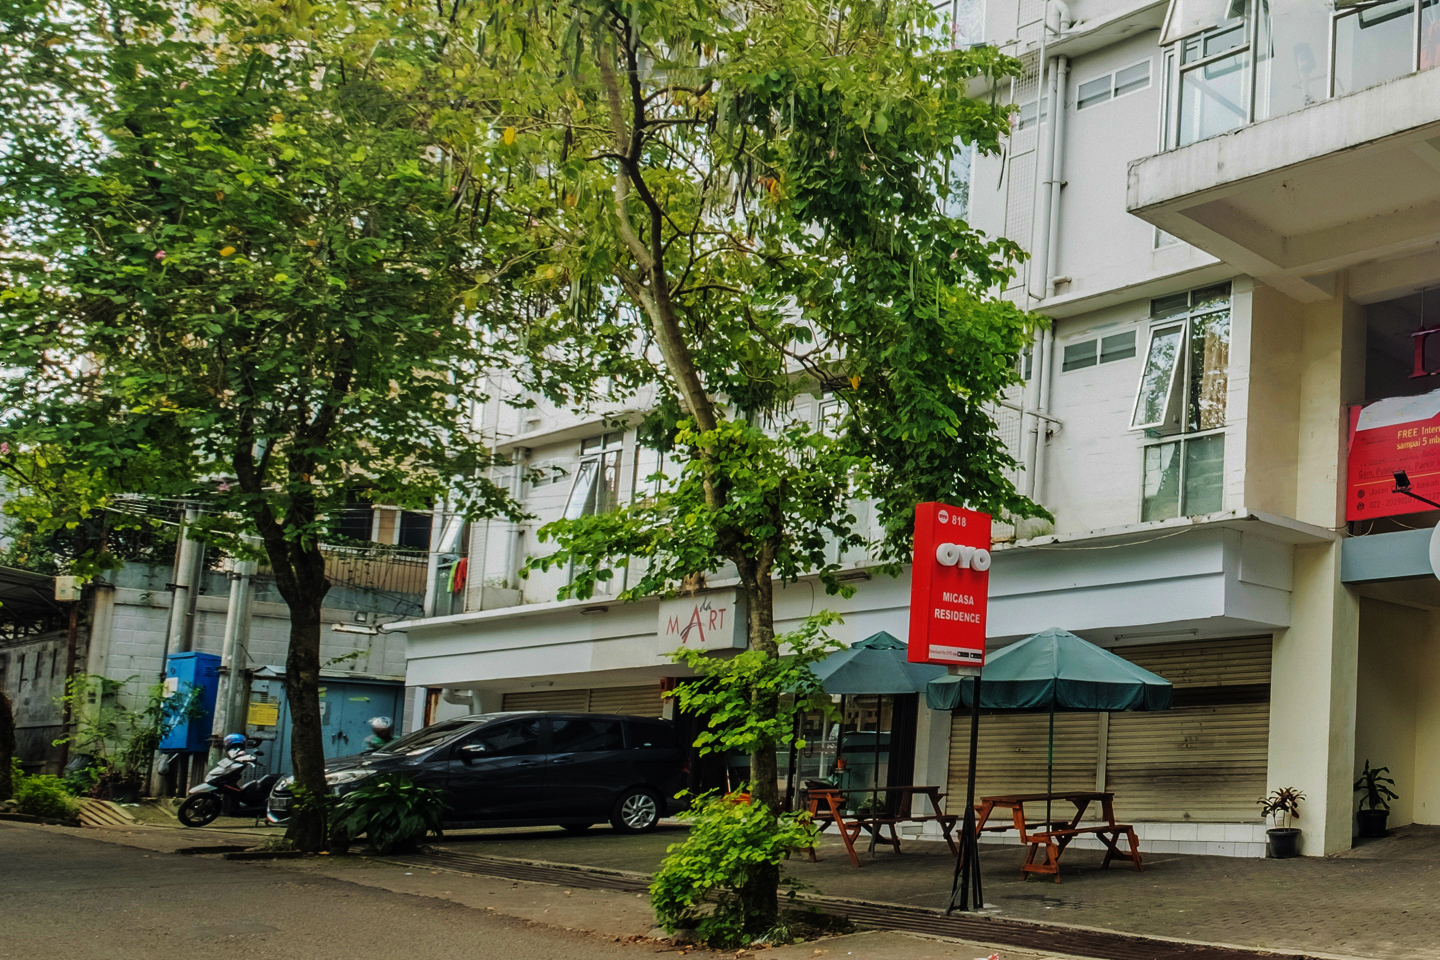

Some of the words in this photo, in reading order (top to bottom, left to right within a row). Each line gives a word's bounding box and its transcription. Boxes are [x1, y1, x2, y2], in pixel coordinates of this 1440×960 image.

[1397, 428, 1418, 440] FREE
[1396, 438, 1421, 450] sampai
[1422, 437, 1427, 446] 5
[1414, 460, 1435, 469] Parkir
[1416, 479, 1440, 489] bawah
[952, 515, 967, 528] 818
[935, 542, 992, 572] OYO
[942, 592, 975, 606] MICASA
[934, 608, 981, 624] RESIDENCE
[666, 604, 727, 644] MART
